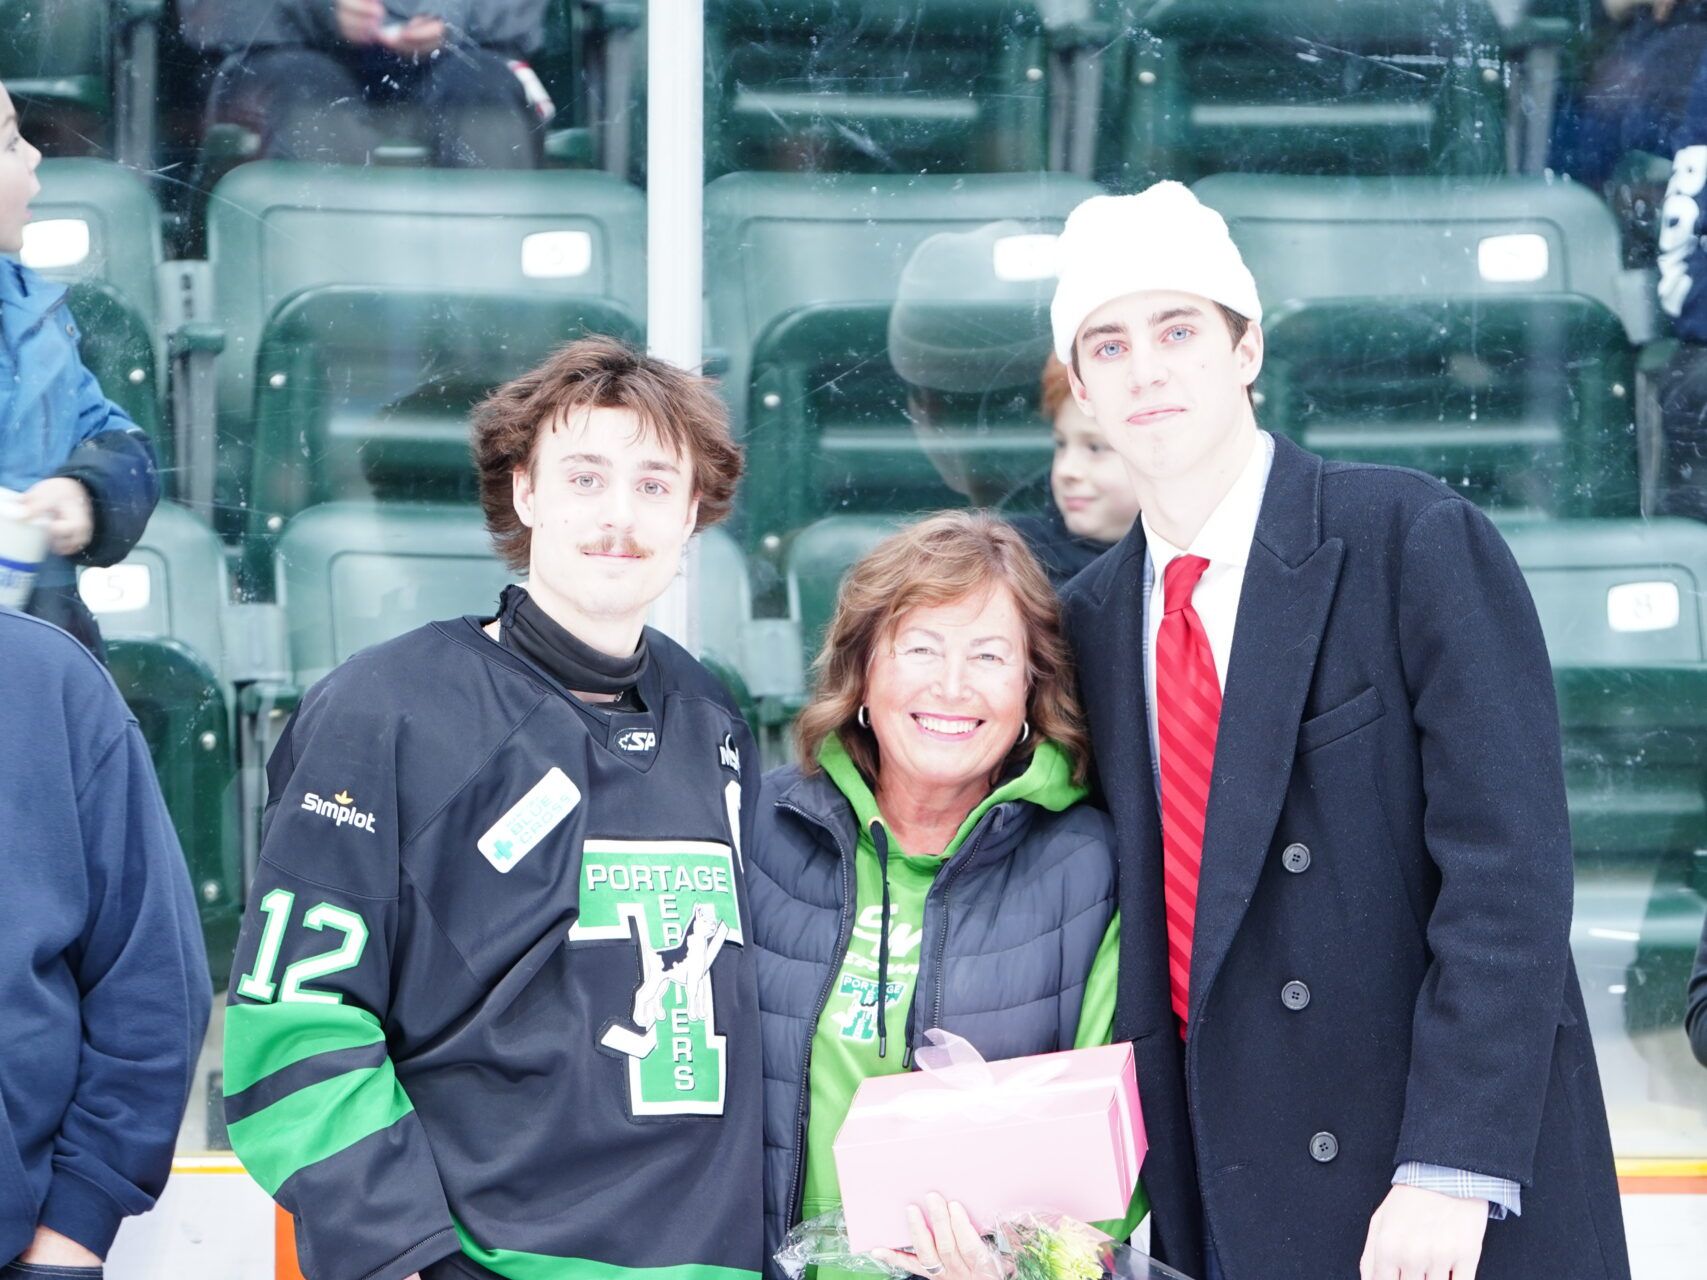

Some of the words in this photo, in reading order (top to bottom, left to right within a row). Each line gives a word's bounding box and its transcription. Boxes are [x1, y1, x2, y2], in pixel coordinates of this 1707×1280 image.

[107, 574, 125, 601] 5
[301, 790, 377, 834] Simplot
[585, 864, 730, 894] PORTAGE
[236, 888, 370, 1005] 12
[843, 976, 902, 994] PORTGE
